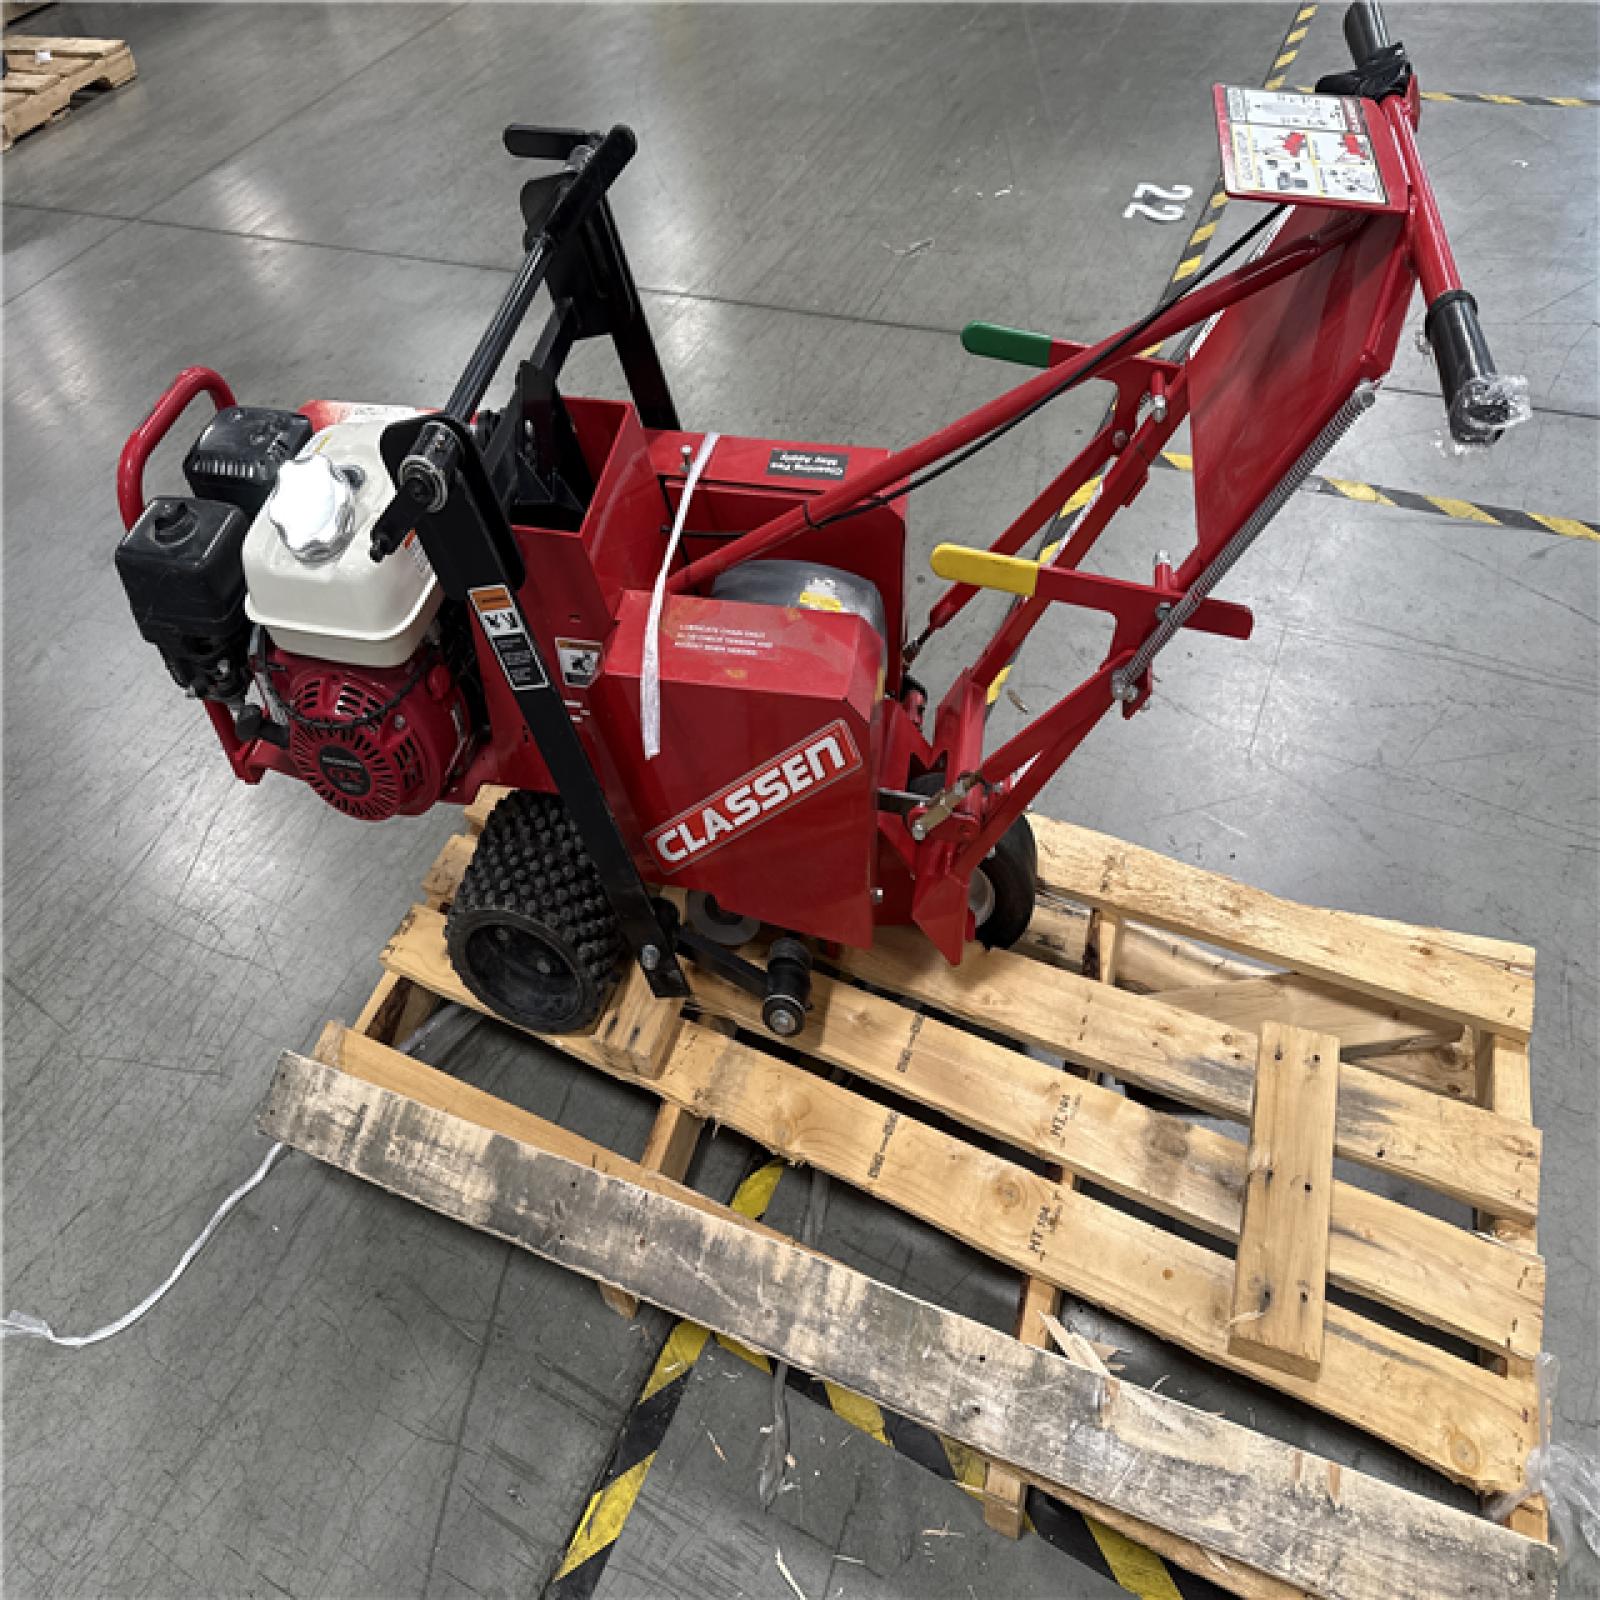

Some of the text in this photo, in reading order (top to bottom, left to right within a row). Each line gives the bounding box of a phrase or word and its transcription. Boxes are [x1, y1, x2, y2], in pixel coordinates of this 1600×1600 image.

[1122, 182, 1193, 221] 22
[769, 461, 844, 476] Cleaning Fee
[656, 737, 846, 861] CLASSEN
